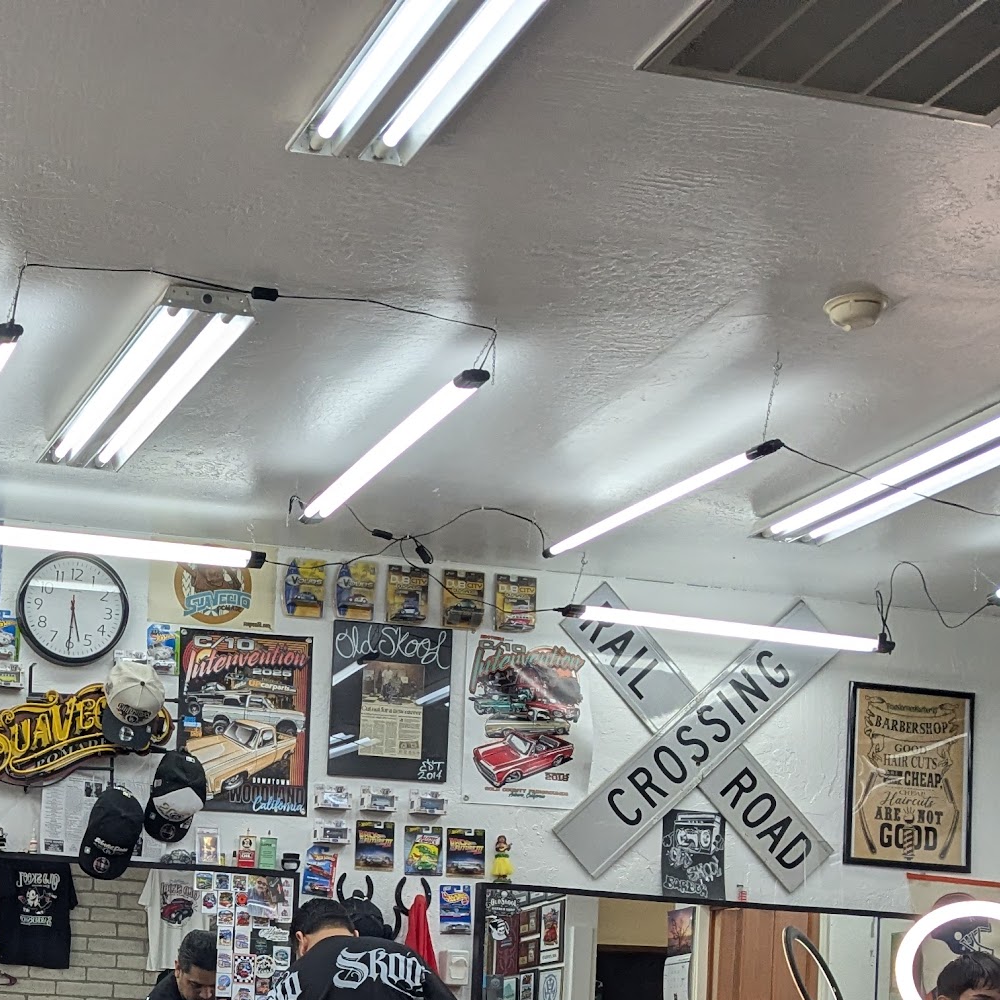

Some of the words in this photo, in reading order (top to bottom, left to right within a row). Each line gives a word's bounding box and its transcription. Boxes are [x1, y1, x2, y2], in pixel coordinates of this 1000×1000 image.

[56, 570, 65, 582] 11
[71, 568, 84, 582] 12
[91, 575, 96, 587] 1
[41, 582, 54, 594] 10
[34, 597, 44, 610] 9
[103, 607, 113, 620] 3
[37, 615, 47, 628] 8
[49, 629, 58, 642] 7
[96, 624, 106, 636] 4
[83, 633, 92, 646] 5
[335, 625, 377, 659] Old
[378, 626, 451, 670] Skool
[184, 642, 309, 697] Intervention
[875, 715, 950, 735] BARBERSHOP
[607, 650, 791, 826] CROSSING
[883, 753, 909, 768] HAIR
[911, 756, 938, 770] CUTS
[417, 770, 443, 780] 2014
[904, 770, 943, 789] CHEAP.
[880, 791, 936, 808] Haircuts
[719, 767, 812, 870] ROAD
[874, 806, 901, 821] ARE
[917, 810, 943, 825] NOT
